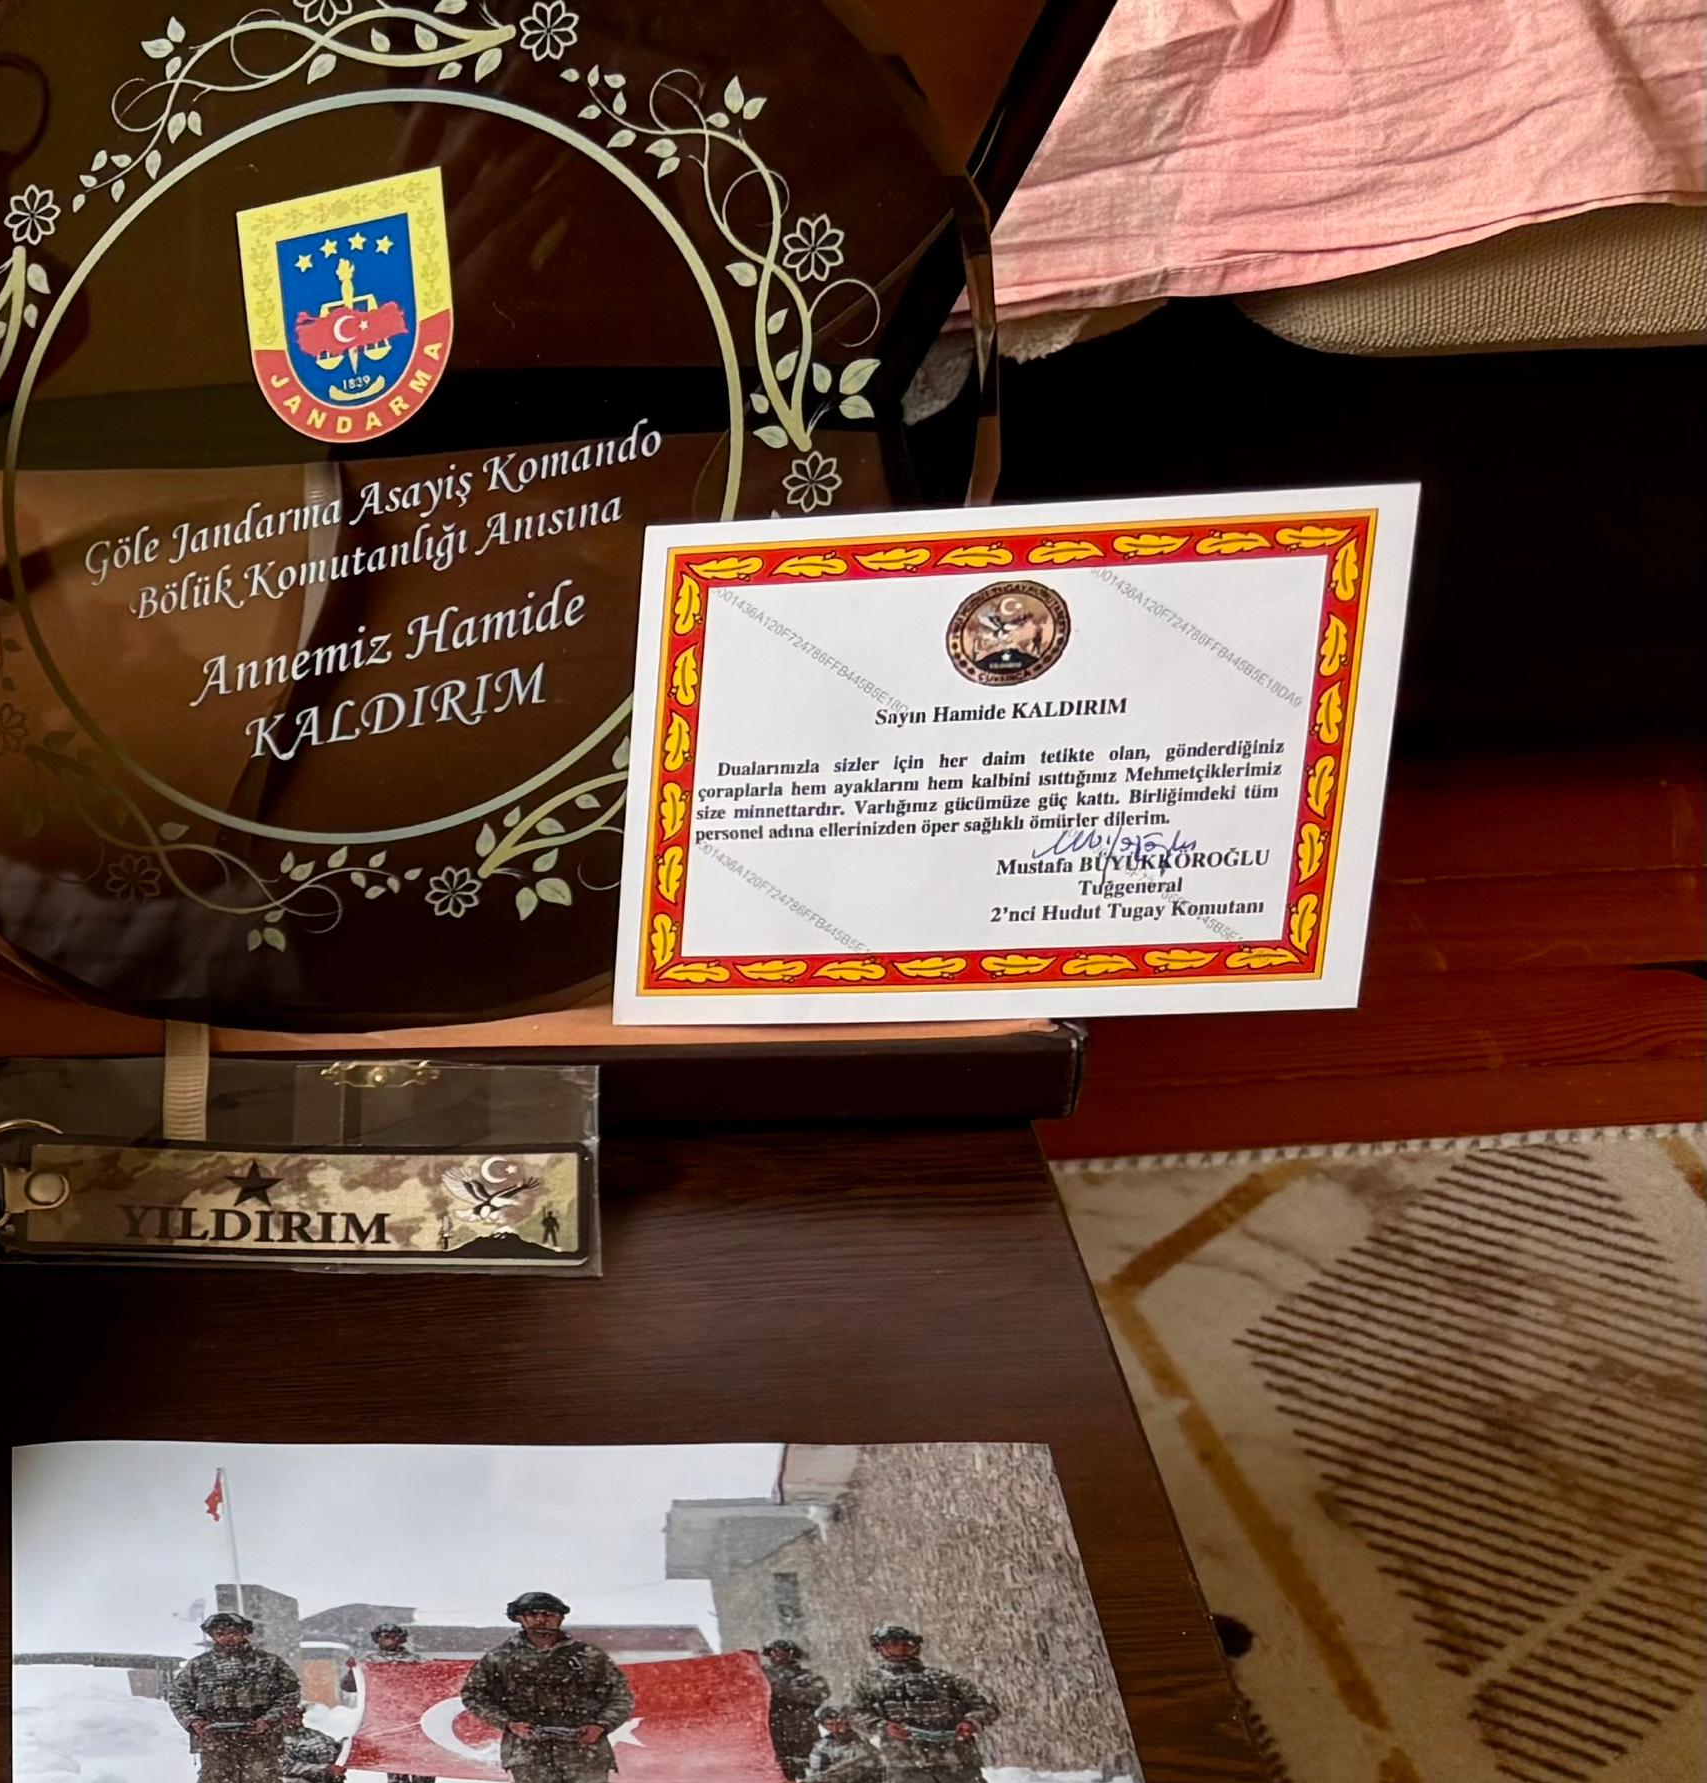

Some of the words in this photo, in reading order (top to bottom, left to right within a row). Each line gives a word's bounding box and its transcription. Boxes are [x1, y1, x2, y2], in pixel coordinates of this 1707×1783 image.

[270, 341, 443, 434] JANDARMA
[343, 375, 370, 390] 1839
[85, 531, 159, 586] Göle
[170, 498, 342, 562] Jandarma
[350, 464, 473, 526] Asayiş
[482, 418, 662, 494] Komando
[129, 574, 245, 620] Bölük
[243, 523, 468, 600] Komutanlığı
[476, 497, 622, 556] Anısına
[190, 624, 393, 706] Annemiz
[406, 579, 587, 660] Hamide
[245, 662, 547, 761] KALDIRIM
[875, 708, 926, 727] Sayın
[933, 704, 1007, 723] Hamide
[1011, 698, 1128, 719] KALDIRIM
[718, 759, 820, 777] Dualarınızla
[834, 756, 880, 772] sizler
[893, 755, 924, 773] için
[939, 753, 968, 769] her
[982, 751, 1025, 767] daim
[1040, 749, 1095, 765] tetikte
[1109, 746, 1151, 763] olan,
[1166, 739, 1284, 761] gönderdiğiniz
[698, 785, 783, 802] çoraplarla
[791, 781, 826, 797] hem
[834, 778, 919, 795] ayaklarını
[927, 775, 963, 791] hem
[972, 772, 1030, 789] kalbini
[1125, 761, 1282, 784] Mehmetçiklerimiz
[696, 806, 726, 820] size
[734, 802, 845, 819] minnettardır.
[855, 798, 937, 817] Varlığınız
[944, 795, 1030, 815] gücümüze
[1038, 793, 1068, 811] güç
[1076, 789, 1119, 806] kattı.
[1129, 785, 1236, 806] Birliğimdeki
[1244, 784, 1279, 800] tüm
[695, 825, 764, 845] personel
[769, 823, 814, 840] adına
[819, 819, 917, 838] ellerinizden
[921, 818, 960, 837] öper
[963, 815, 1024, 834] sağlıklı
[1030, 811, 1099, 830] ömürler
[1104, 808, 1170, 828] dilerim.
[996, 857, 1073, 876] Mustafa
[1080, 849, 1270, 873] BÜYÜKKÖROĞLU
[1078, 877, 1183, 898] Tuğgeneral
[990, 904, 1036, 922] 2'nci
[1042, 903, 1100, 921] Hudut
[1107, 902, 1165, 922] Tugay
[1172, 900, 1264, 916] Komutanı
[119, 1205, 390, 1245] YILDIRIM
